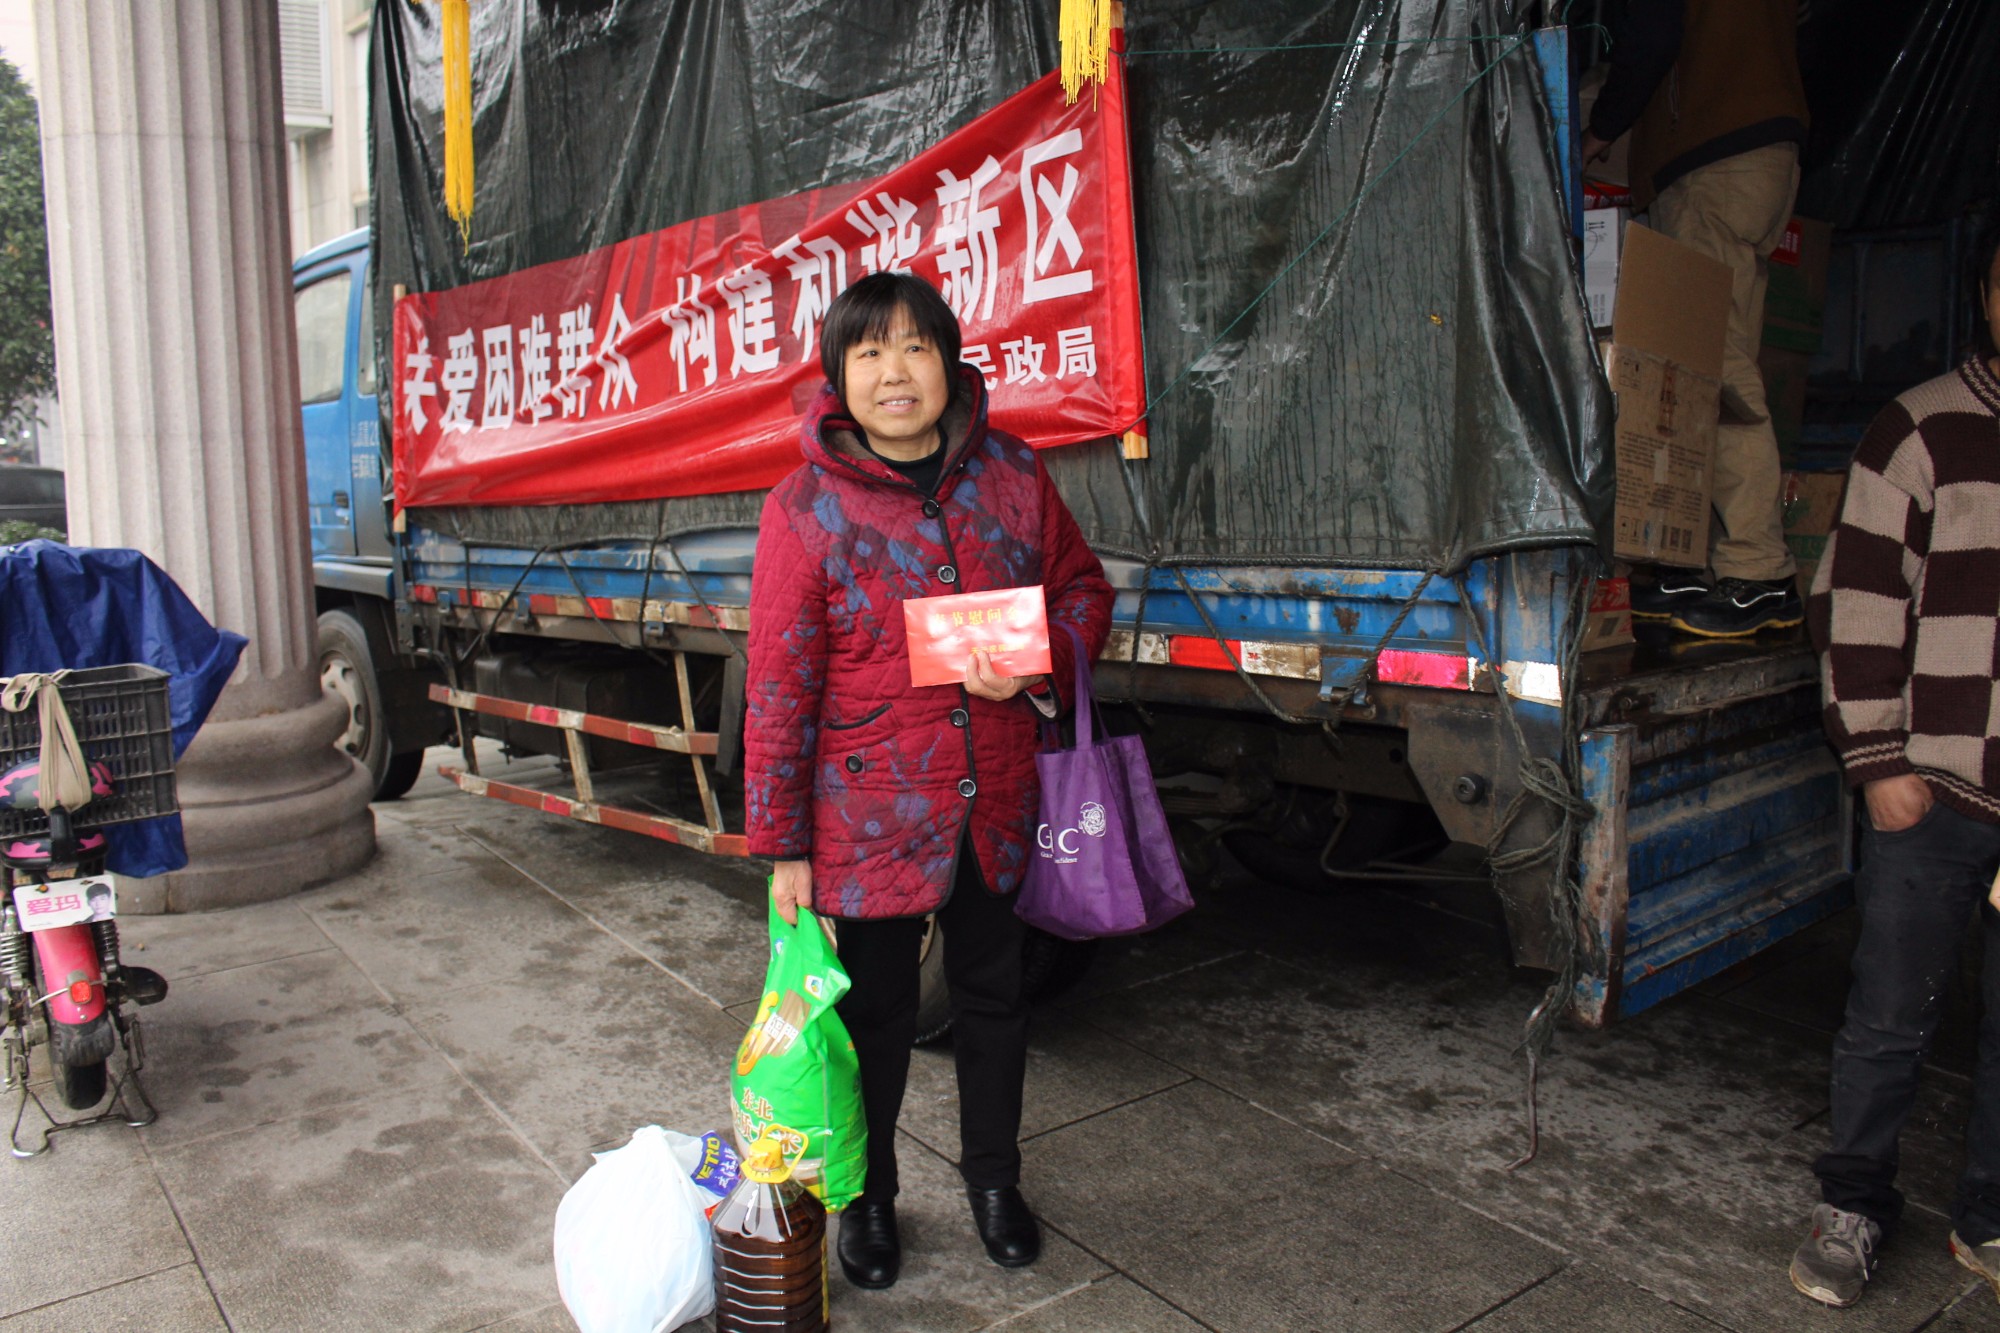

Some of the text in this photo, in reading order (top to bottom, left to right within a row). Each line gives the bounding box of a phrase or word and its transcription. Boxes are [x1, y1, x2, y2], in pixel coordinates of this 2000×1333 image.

[404, 128, 1093, 435] 关爱困难群众 构建和谐新区
[26, 894, 81, 916] 爱玛
[741, 1087, 773, 1121] 东北
